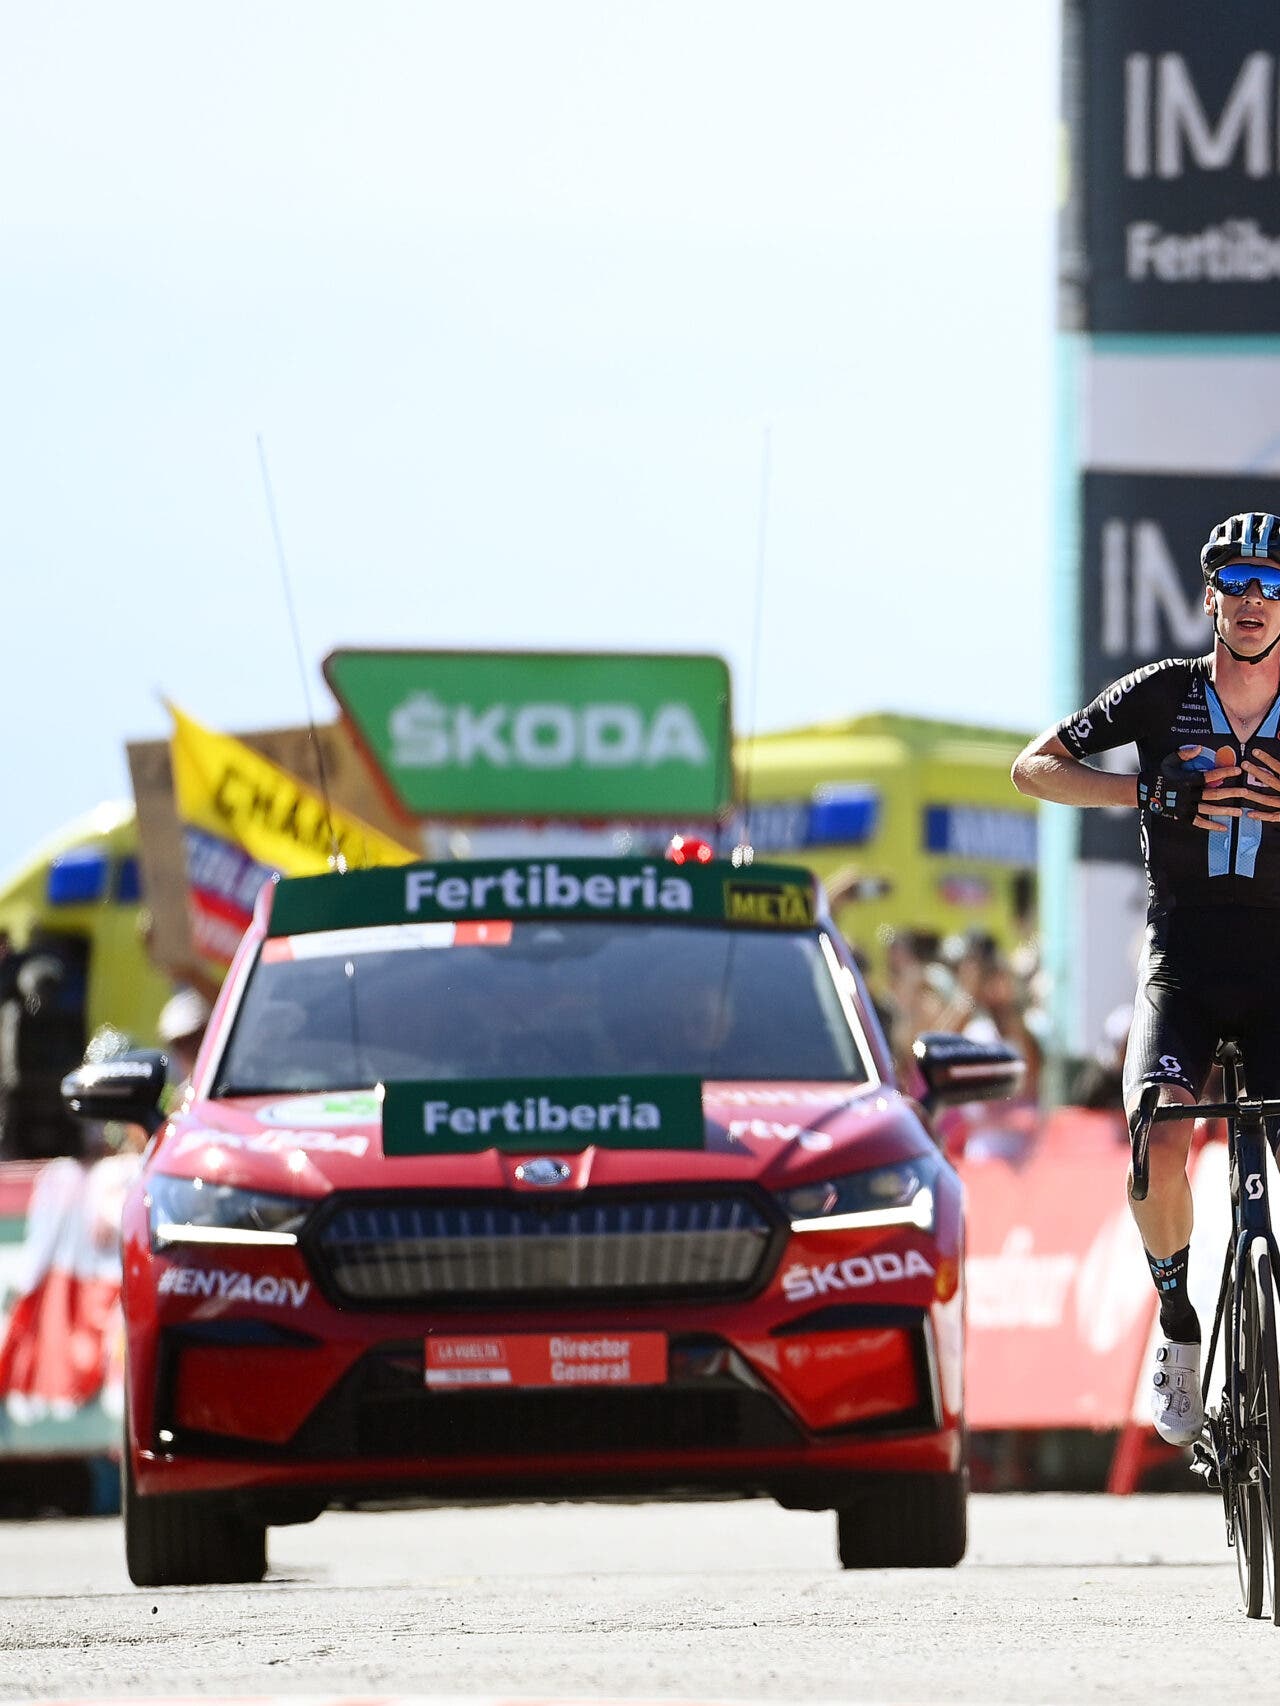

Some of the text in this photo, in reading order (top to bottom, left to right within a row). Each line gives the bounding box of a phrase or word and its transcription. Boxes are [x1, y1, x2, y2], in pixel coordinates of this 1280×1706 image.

[388, 693, 709, 768] ŠKODA
[1154, 775, 1164, 798] DSM
[404, 866, 695, 914] Fertiberia
[422, 1096, 661, 1136] Fertiberia
[781, 1249, 936, 1302] ŠKODA
[550, 1337, 631, 1358] Director
[551, 1359, 631, 1381] General
